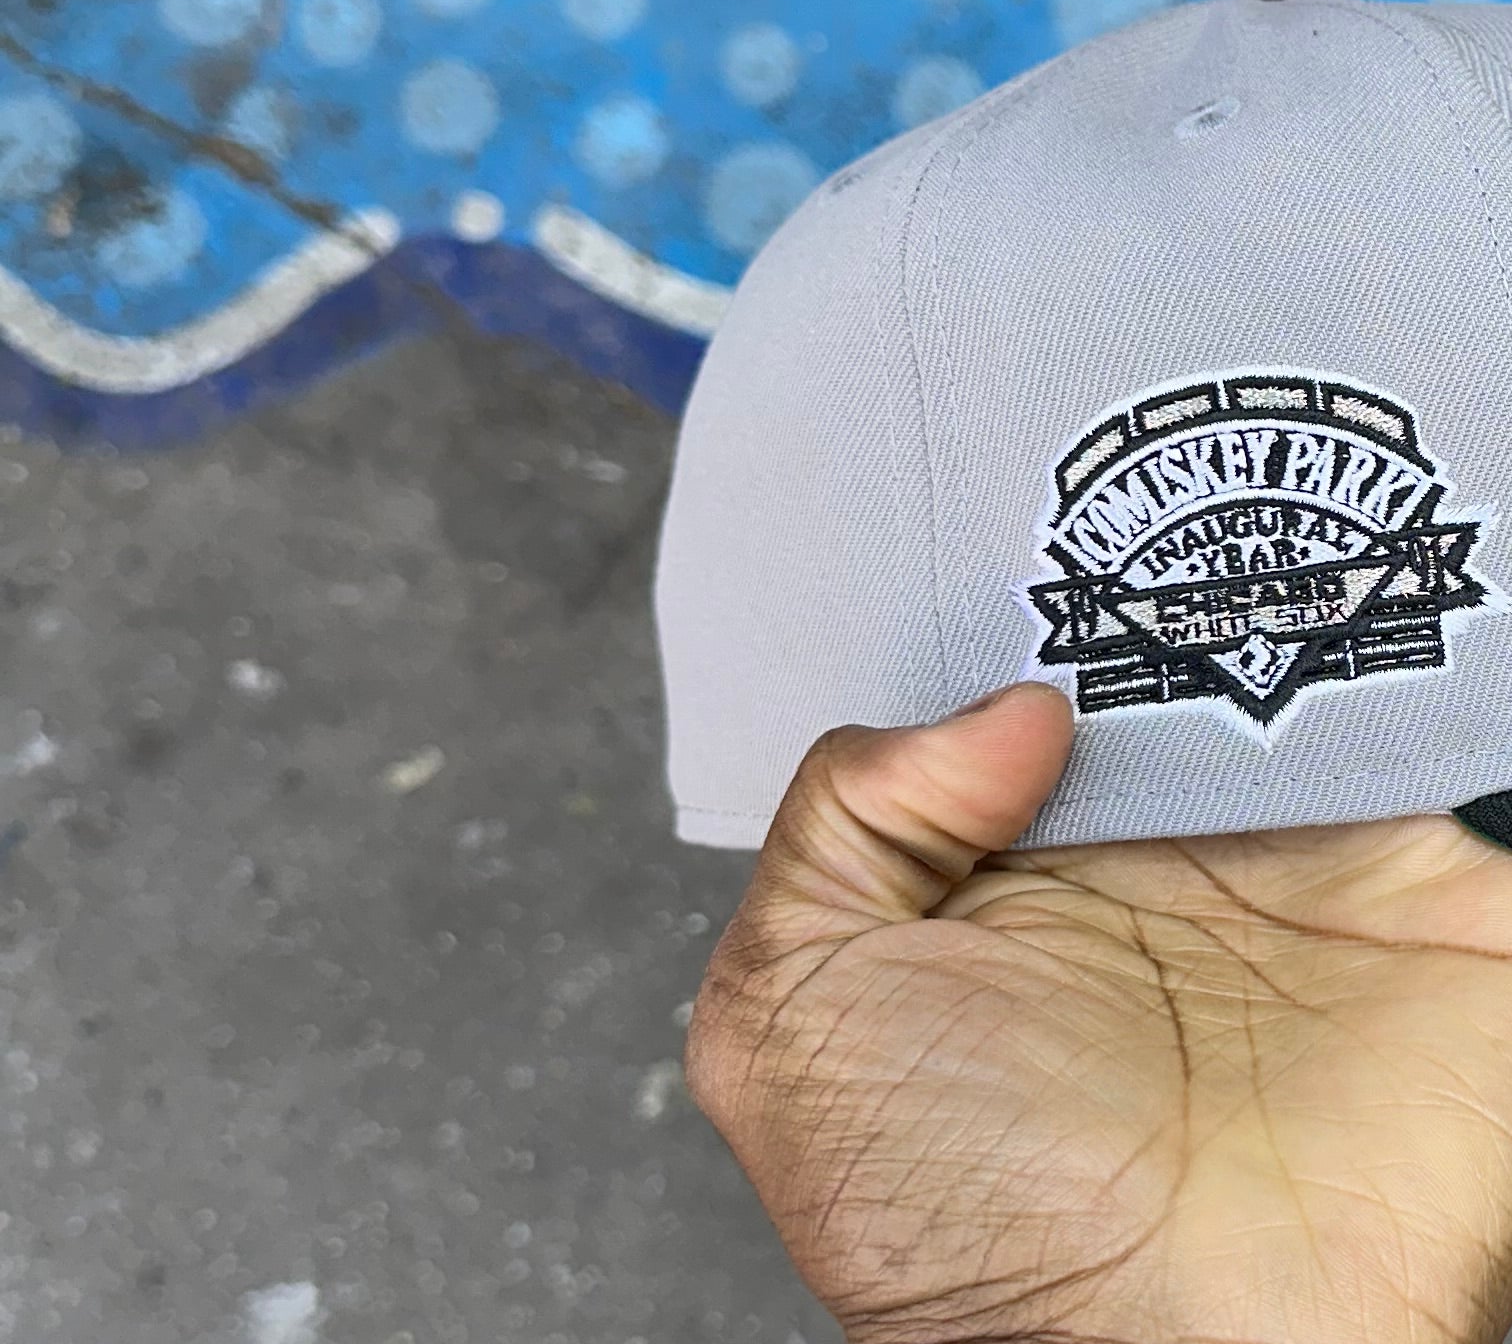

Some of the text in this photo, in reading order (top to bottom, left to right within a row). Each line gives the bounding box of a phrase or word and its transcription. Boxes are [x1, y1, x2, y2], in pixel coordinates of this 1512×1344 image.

[1072, 429, 1424, 562] COMISKEY PARK
[1139, 507, 1357, 581] INAUGURAL
[1205, 538, 1300, 578] YEAR
[1274, 603, 1344, 629] SOX
